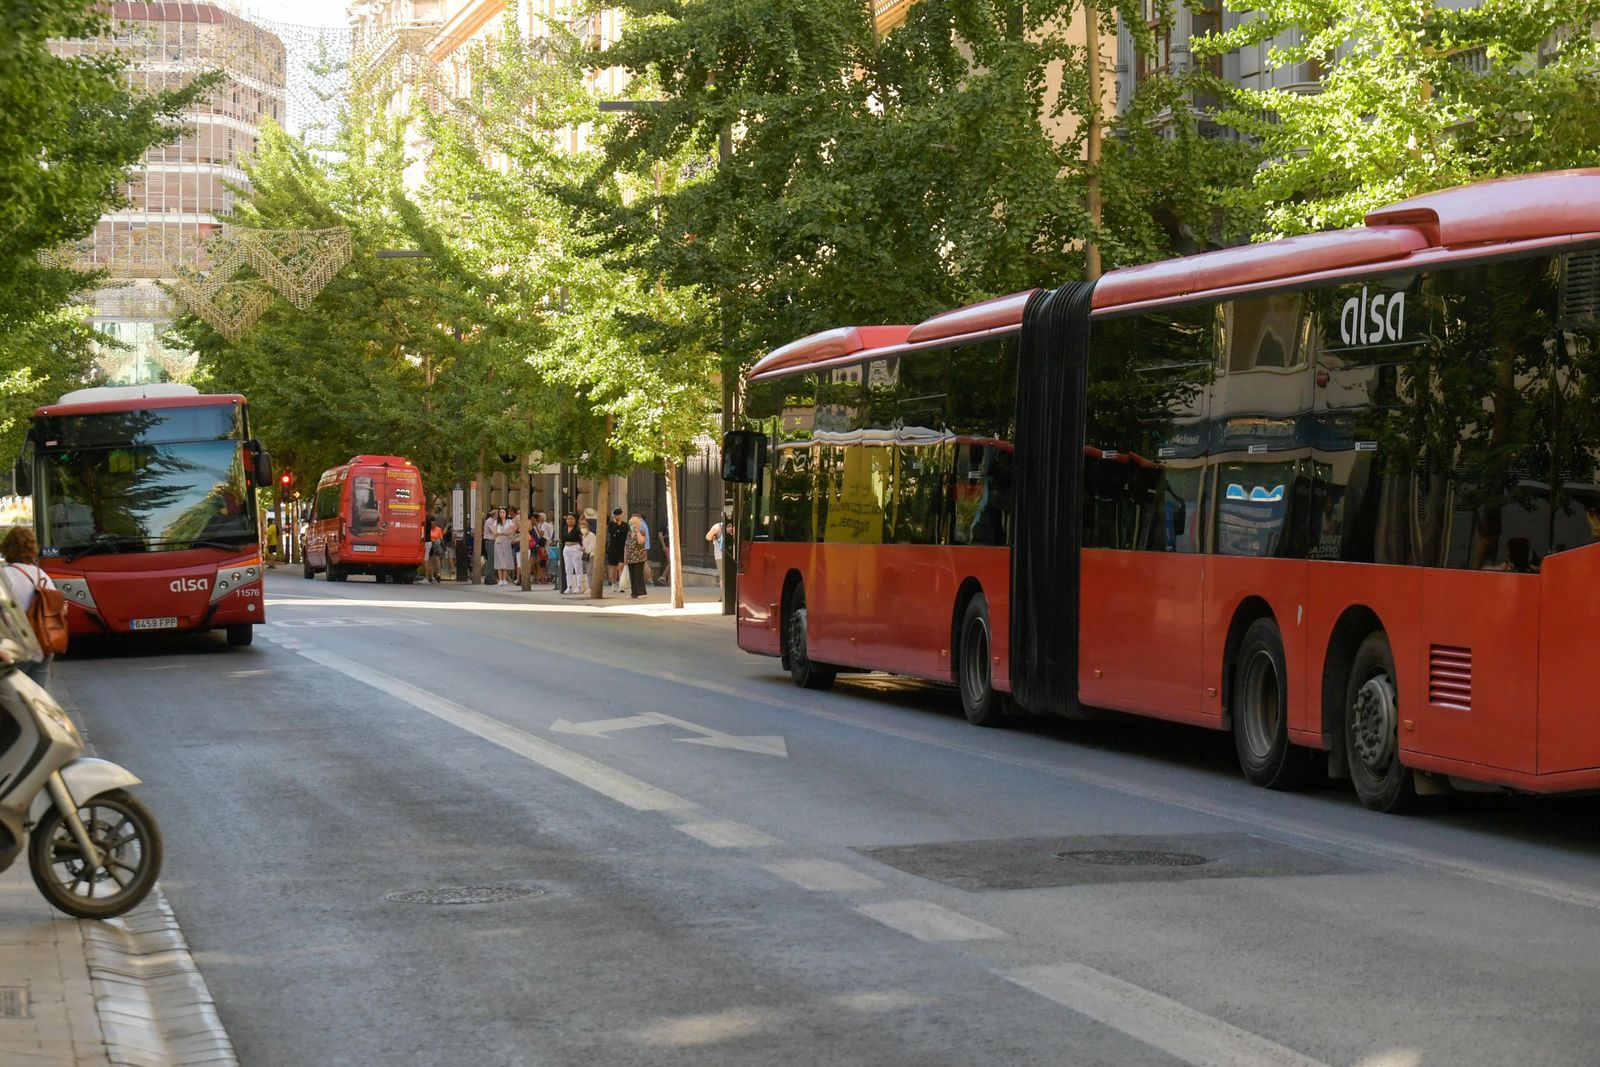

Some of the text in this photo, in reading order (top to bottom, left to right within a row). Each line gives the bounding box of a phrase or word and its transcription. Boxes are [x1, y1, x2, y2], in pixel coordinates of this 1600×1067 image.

[1340, 285, 1405, 345] alsa
[170, 578, 208, 592] alsa
[236, 588, 260, 597] 11576
[135, 618, 176, 629] 6459 FPP
